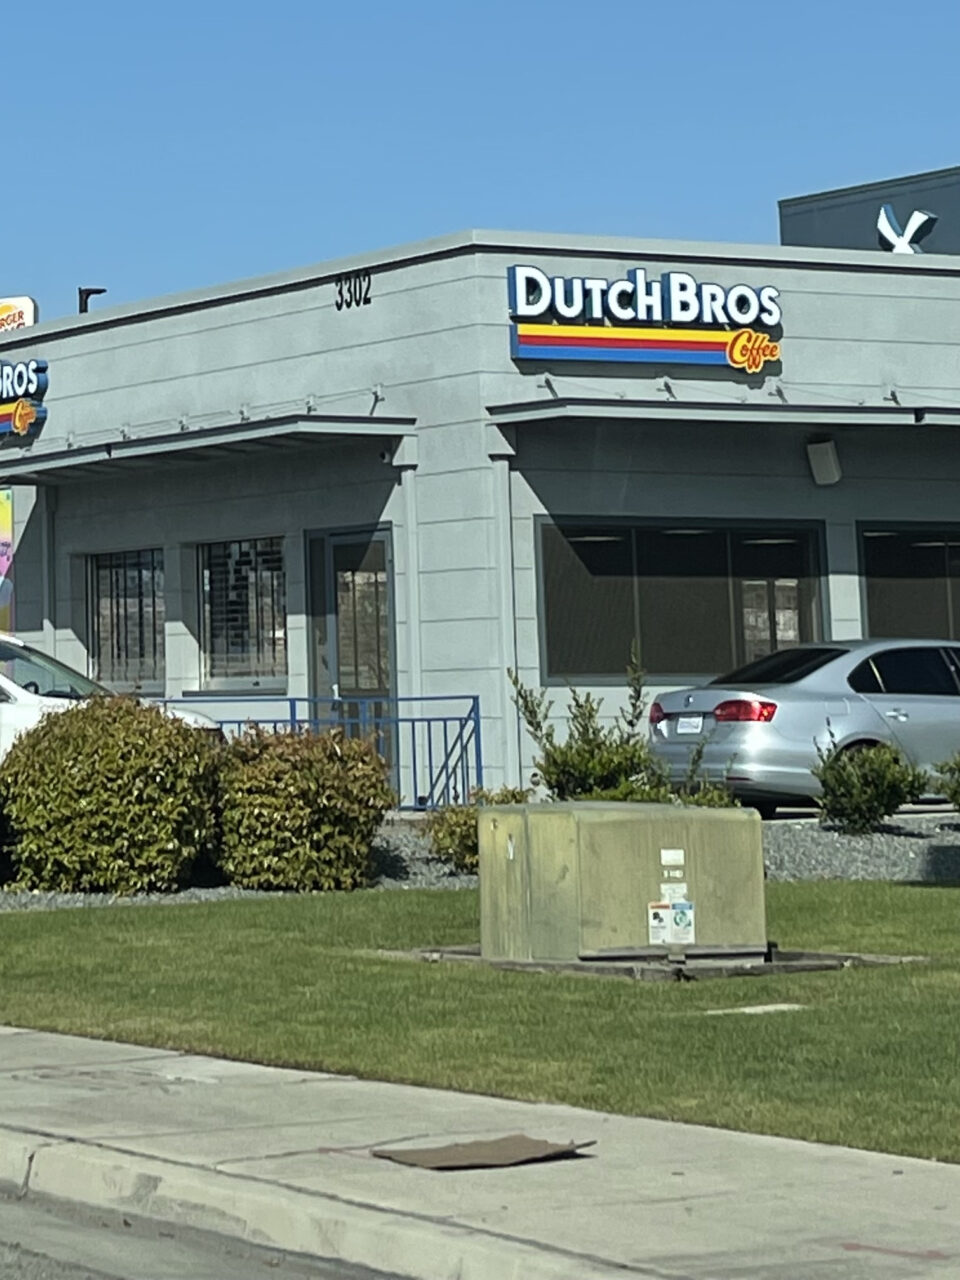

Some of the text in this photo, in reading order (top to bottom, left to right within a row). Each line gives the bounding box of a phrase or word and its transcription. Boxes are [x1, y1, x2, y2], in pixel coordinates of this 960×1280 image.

[334, 271, 372, 312] 3302
[514, 265, 782, 326] DUTCH BROS
[728, 329, 780, 371] Coffee
